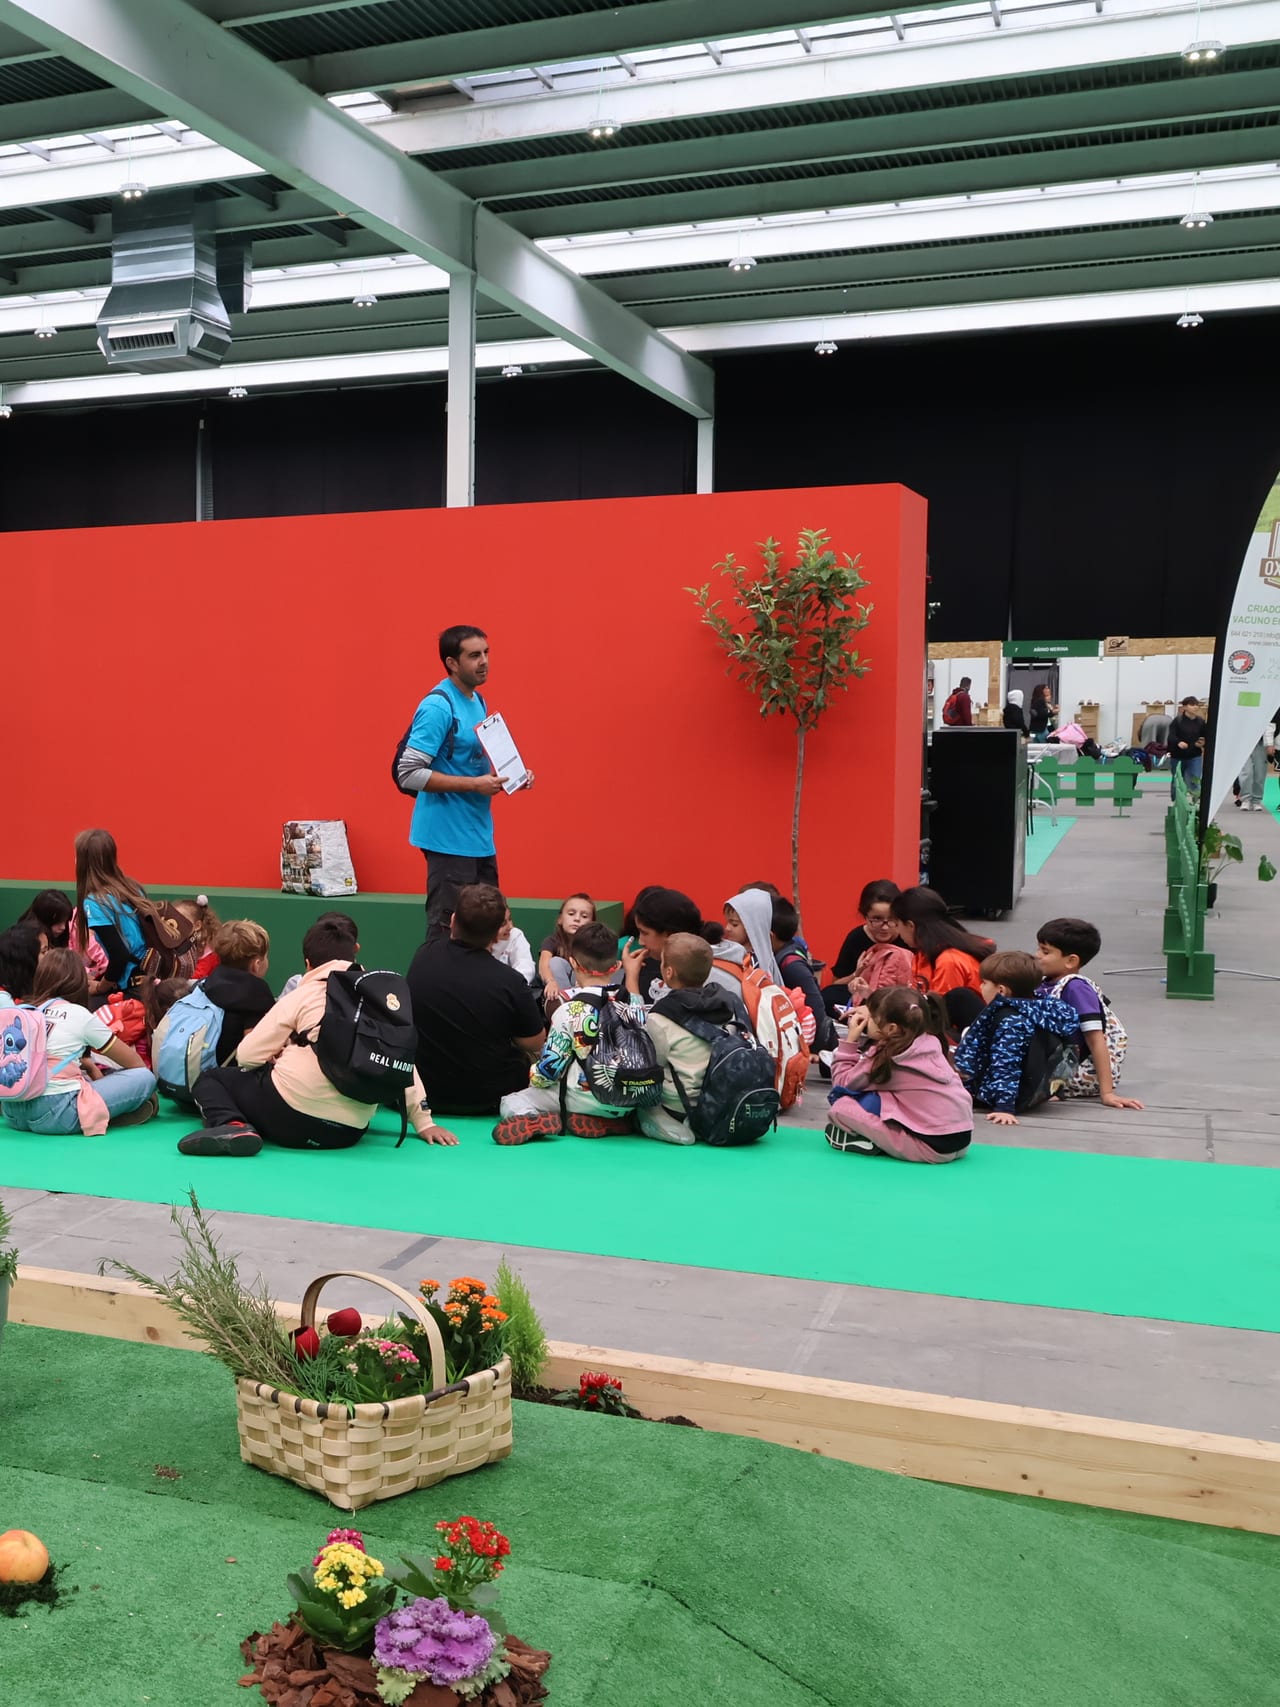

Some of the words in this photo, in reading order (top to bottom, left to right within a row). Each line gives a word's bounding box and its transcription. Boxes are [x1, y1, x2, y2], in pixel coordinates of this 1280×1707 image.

[1233, 616, 1270, 625] VACUNO
[369, 1051, 390, 1067] REAL
[392, 1059, 414, 1073] MADRI
